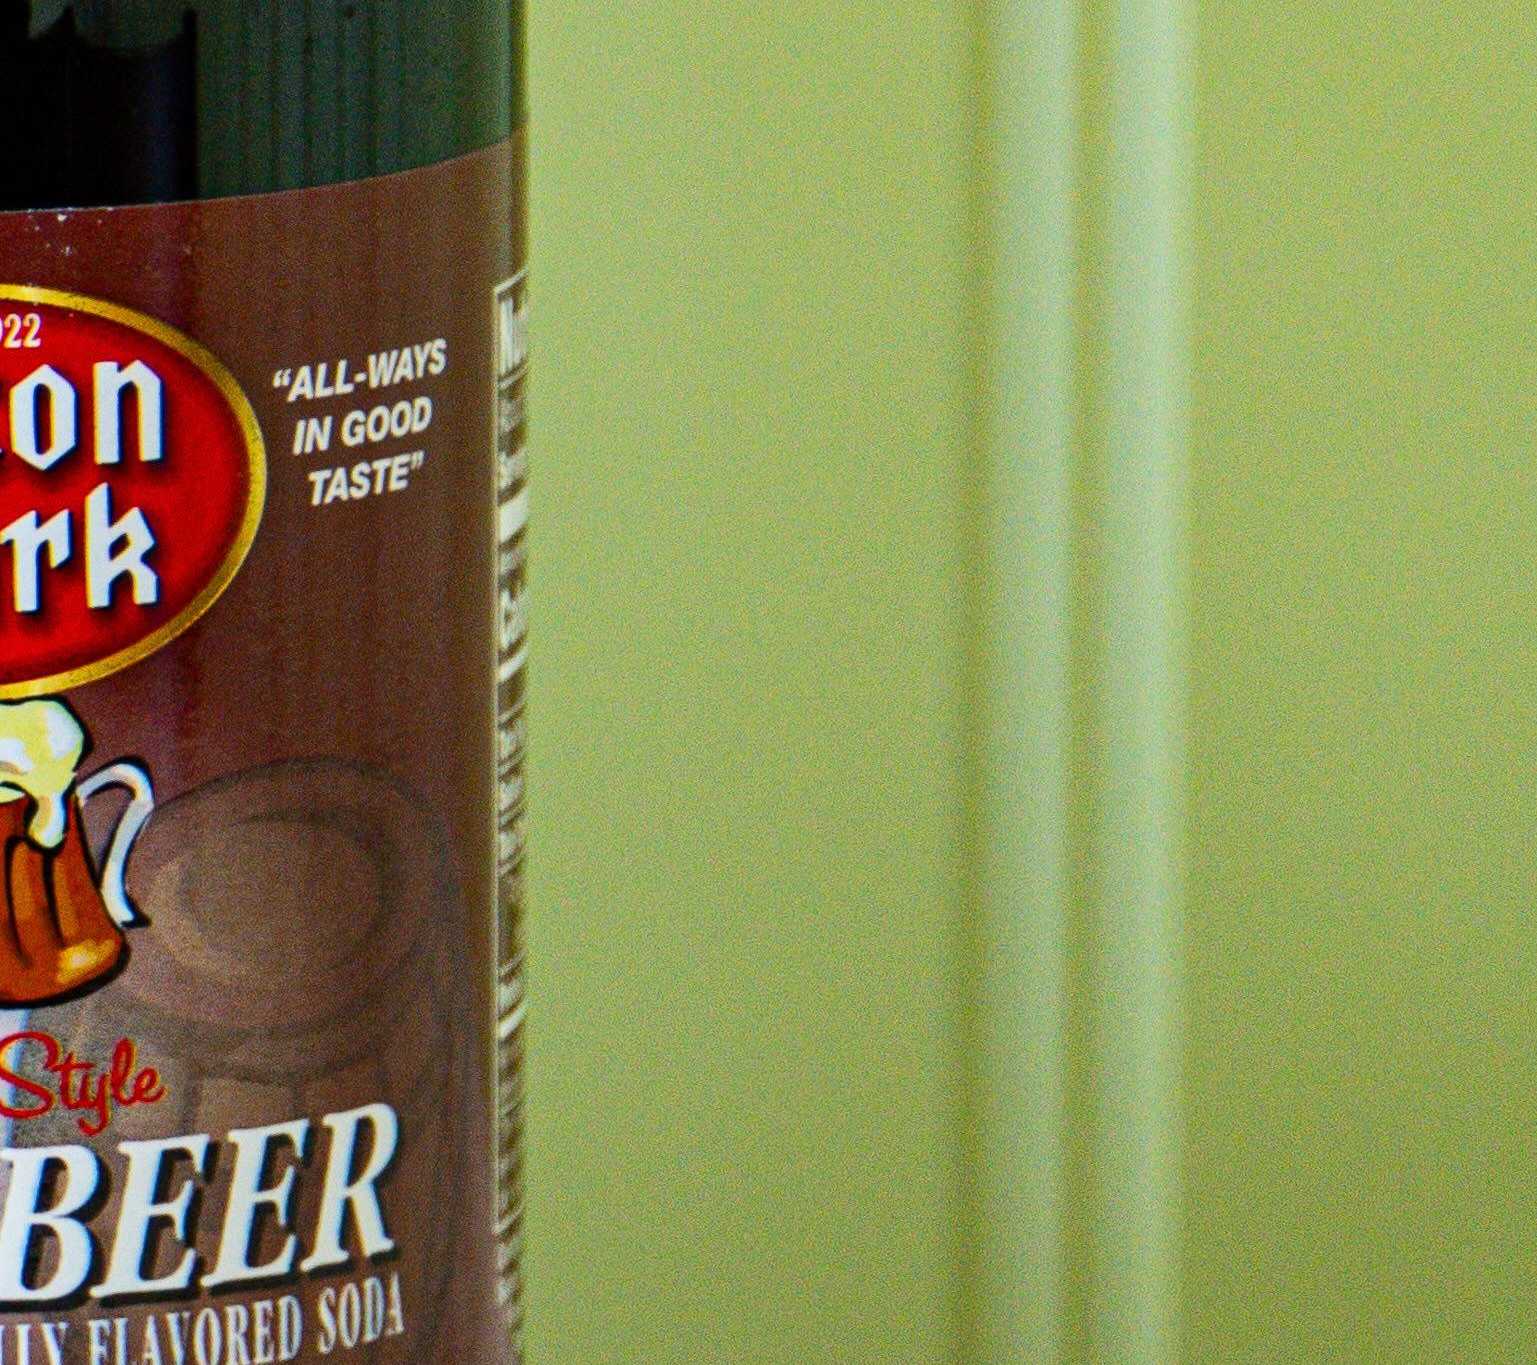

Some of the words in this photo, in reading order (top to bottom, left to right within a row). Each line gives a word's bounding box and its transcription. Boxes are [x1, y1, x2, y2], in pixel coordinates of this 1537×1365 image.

[292, 415, 333, 456] IN
[341, 396, 433, 447] GOOD
[318, 1273, 405, 1354] SODA
